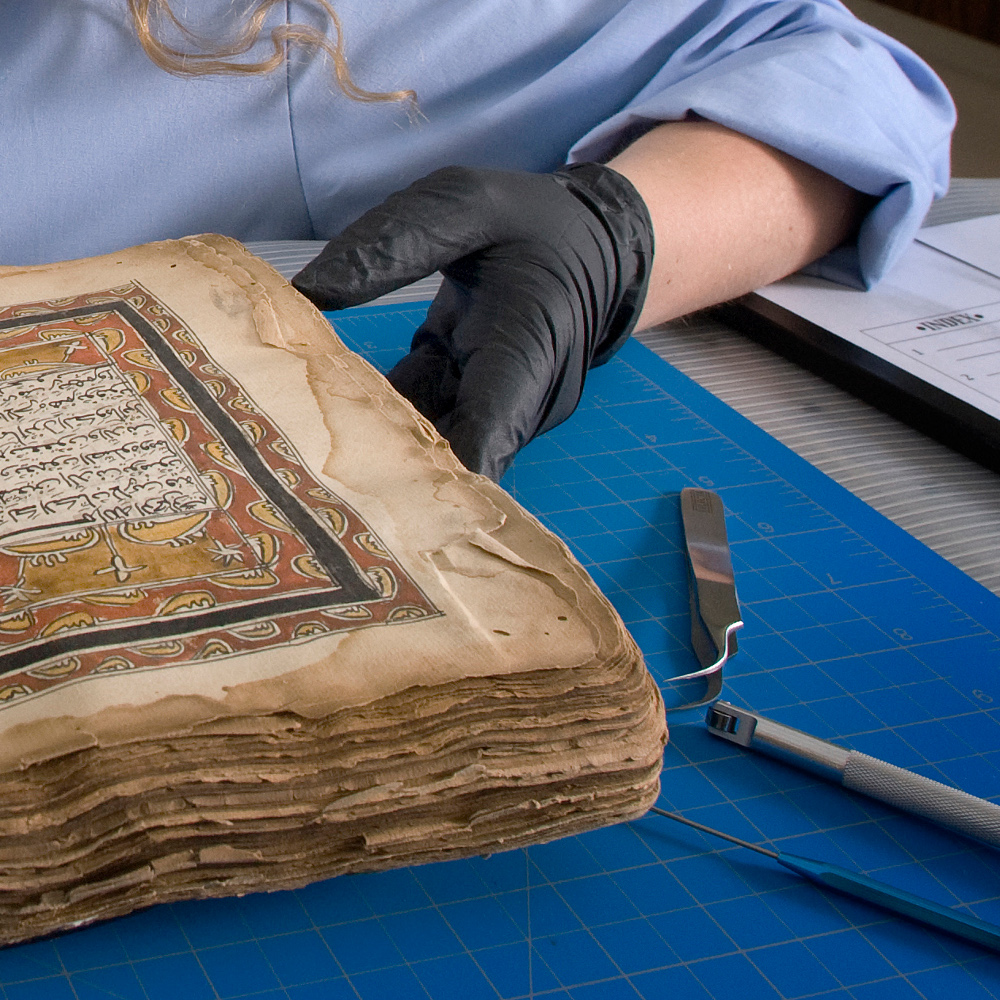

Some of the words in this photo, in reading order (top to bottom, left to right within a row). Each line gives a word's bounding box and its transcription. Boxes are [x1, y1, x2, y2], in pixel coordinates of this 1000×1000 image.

[923, 313, 975, 331] INDEX
[960, 373, 975, 382] 2
[645, 433, 657, 443] 4
[892, 628, 914, 641] 8
